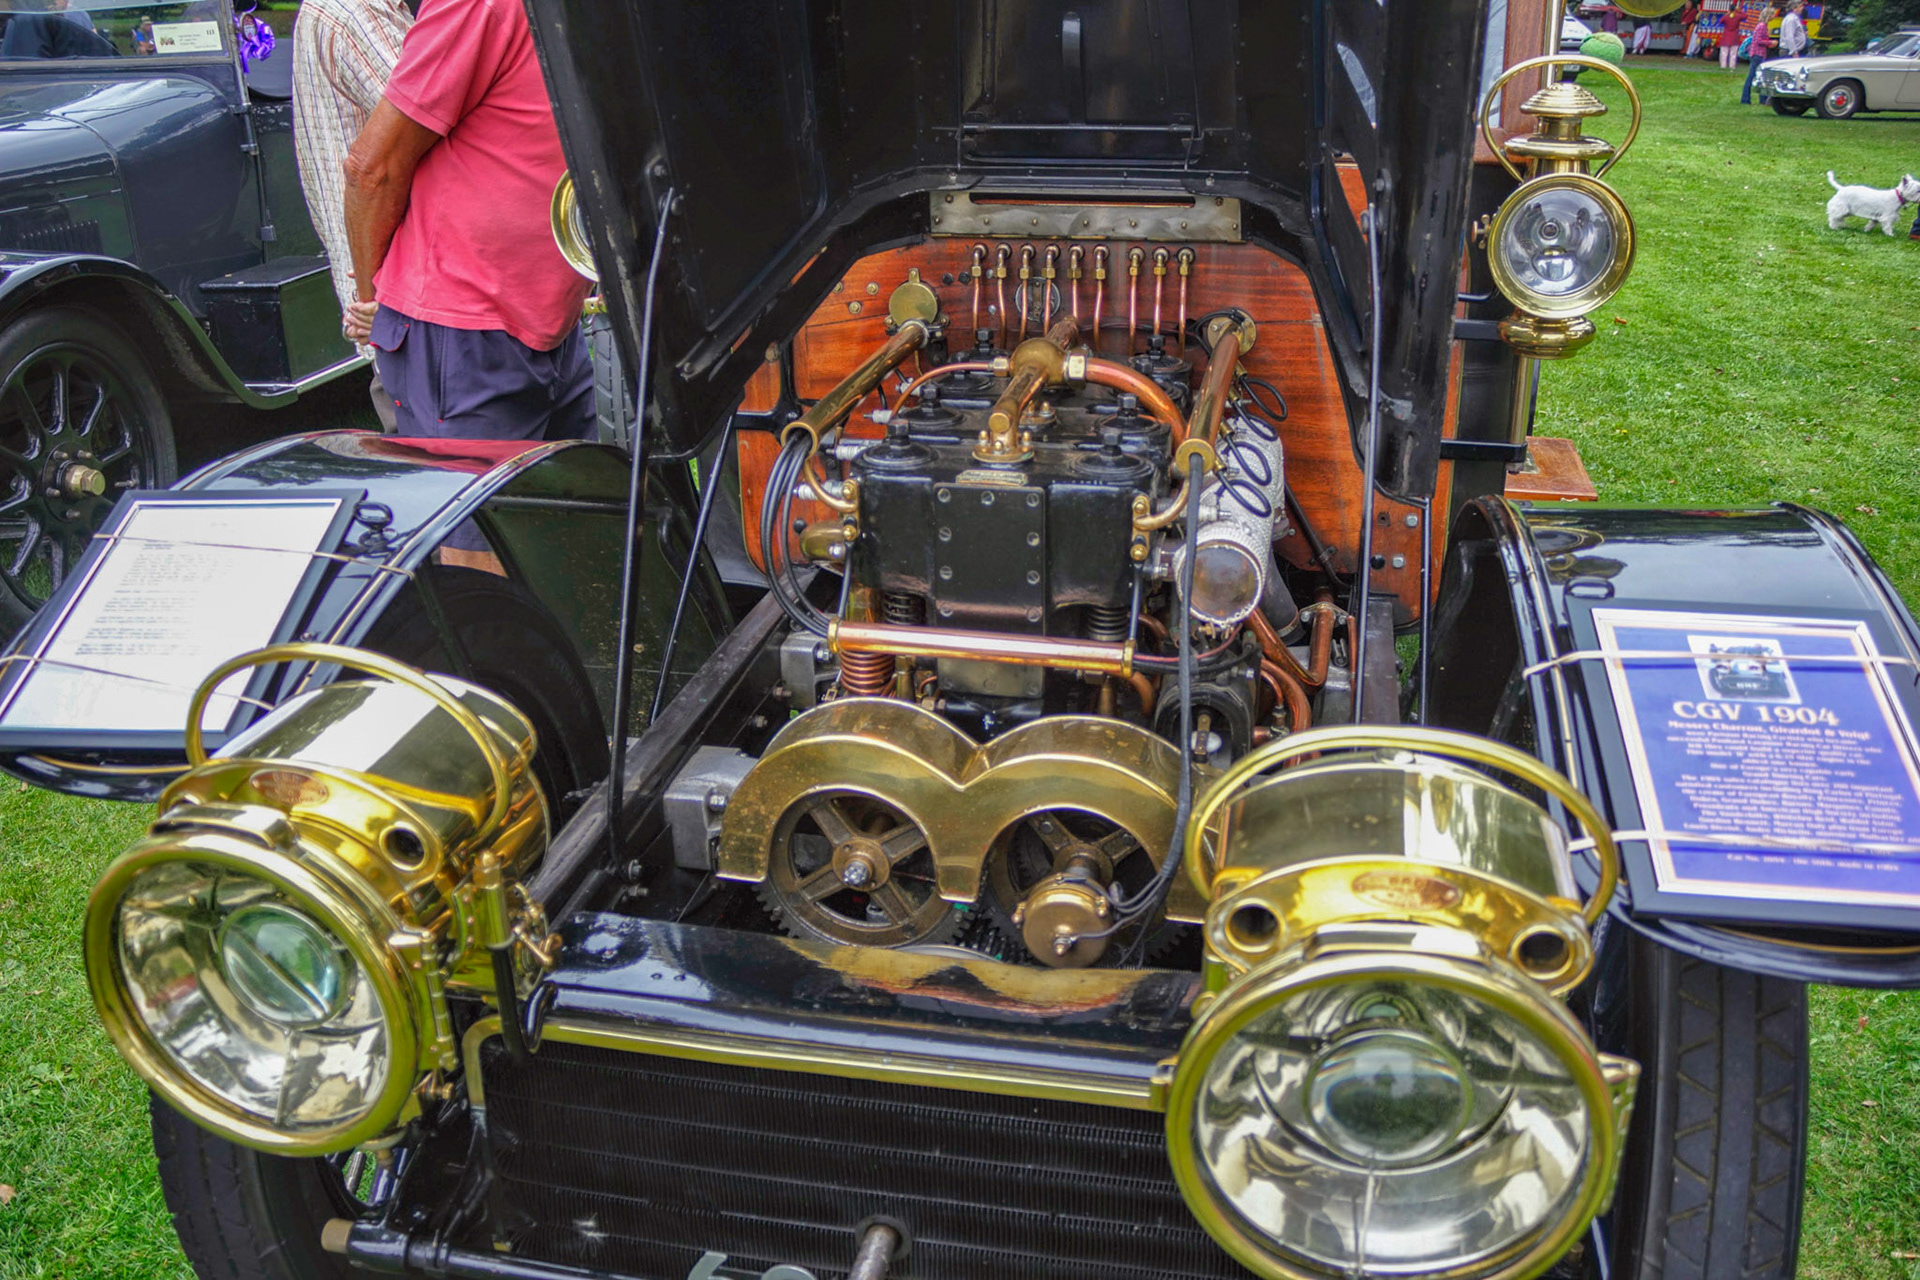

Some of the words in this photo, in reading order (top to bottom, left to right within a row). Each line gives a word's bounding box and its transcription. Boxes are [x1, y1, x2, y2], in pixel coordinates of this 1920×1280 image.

[1672, 701, 1741, 721] CGV
[1755, 706, 1840, 727] 1904
[1668, 720, 1710, 730] Messrs
[1770, 726, 1820, 736] Girardot
[1824, 729, 1835, 737] &
[1838, 730, 1870, 741] Voigt
